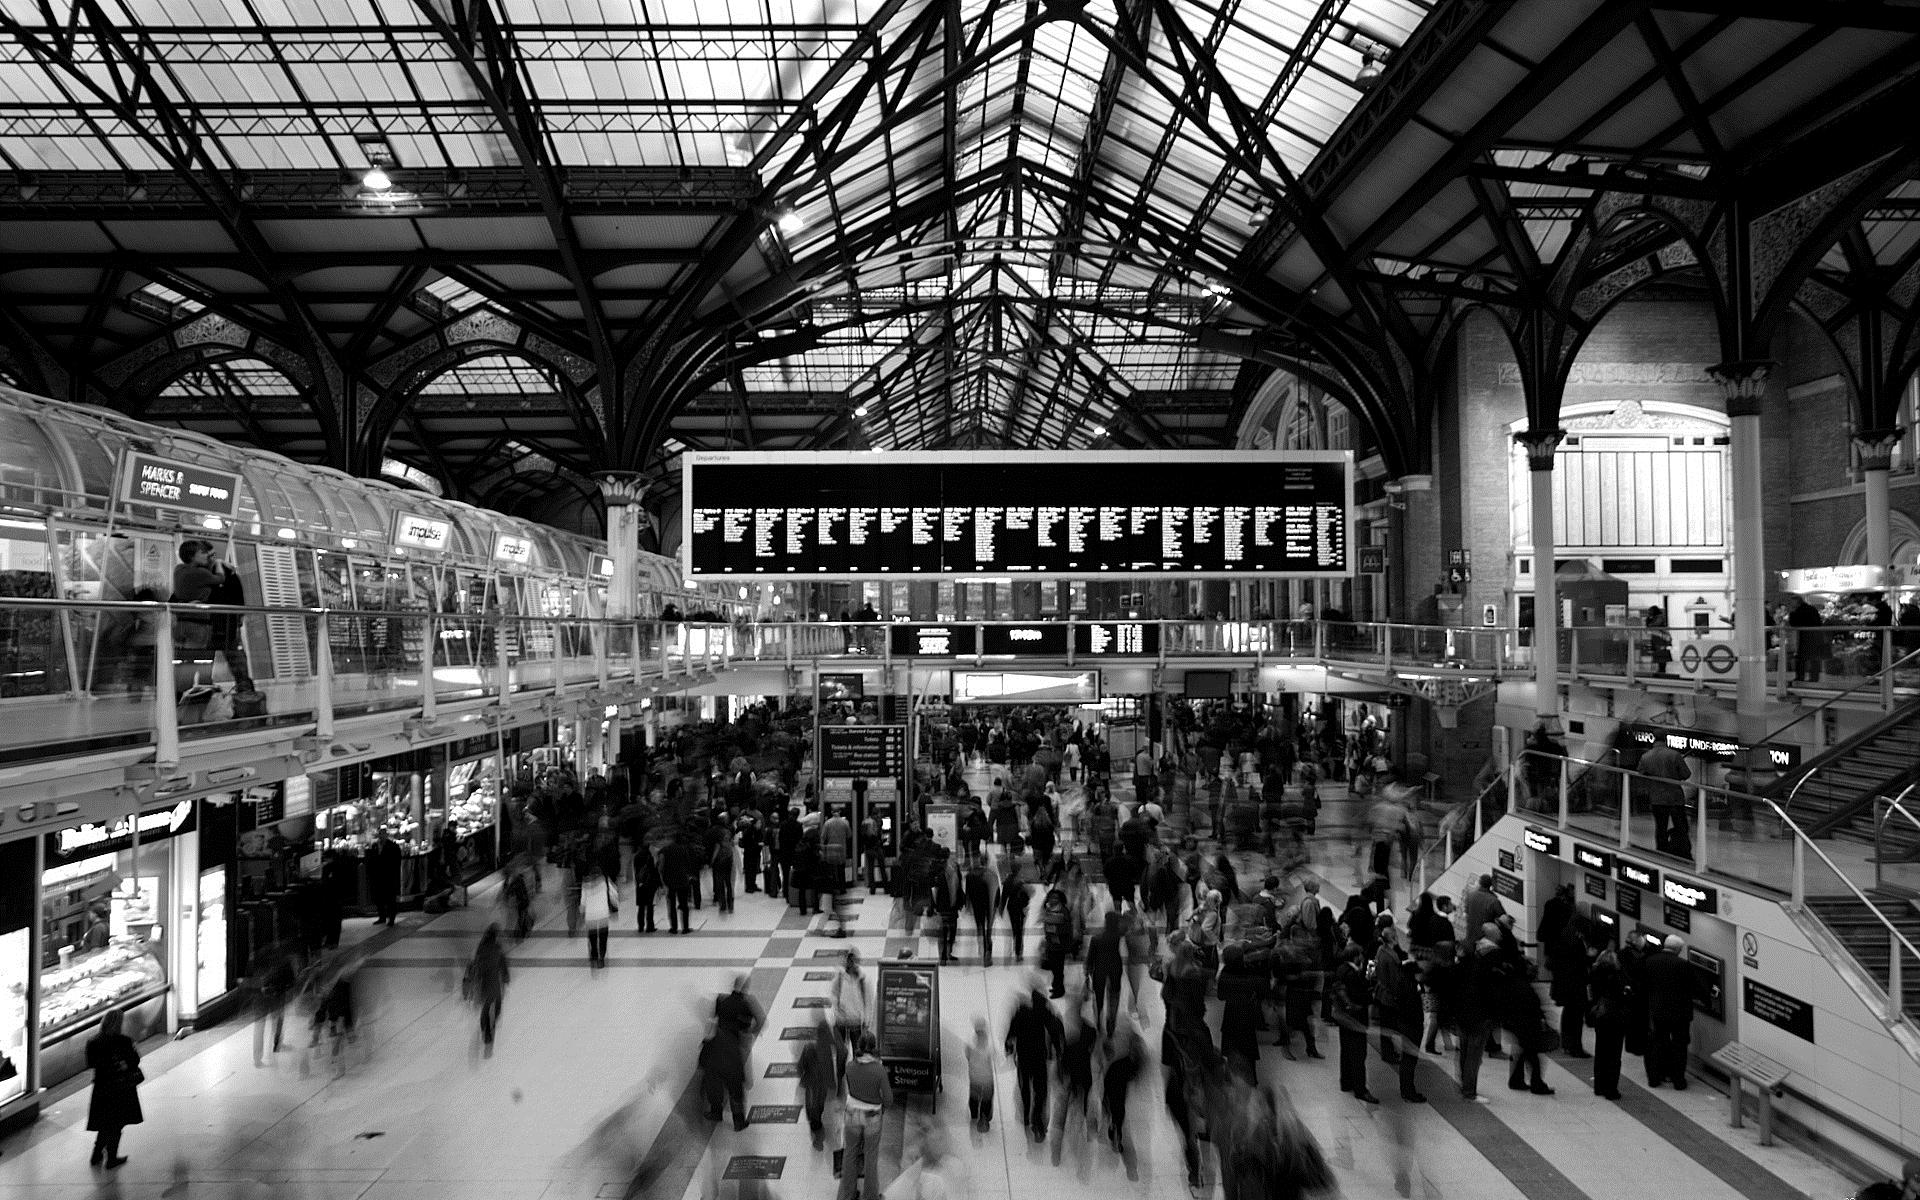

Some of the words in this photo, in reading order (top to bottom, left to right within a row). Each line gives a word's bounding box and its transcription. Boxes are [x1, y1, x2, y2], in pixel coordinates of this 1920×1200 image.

[142, 465, 176, 483] MARKS
[140, 481, 181, 500] SPENCER
[408, 523, 441, 543] impulse
[1666, 734, 1688, 749] TREET
